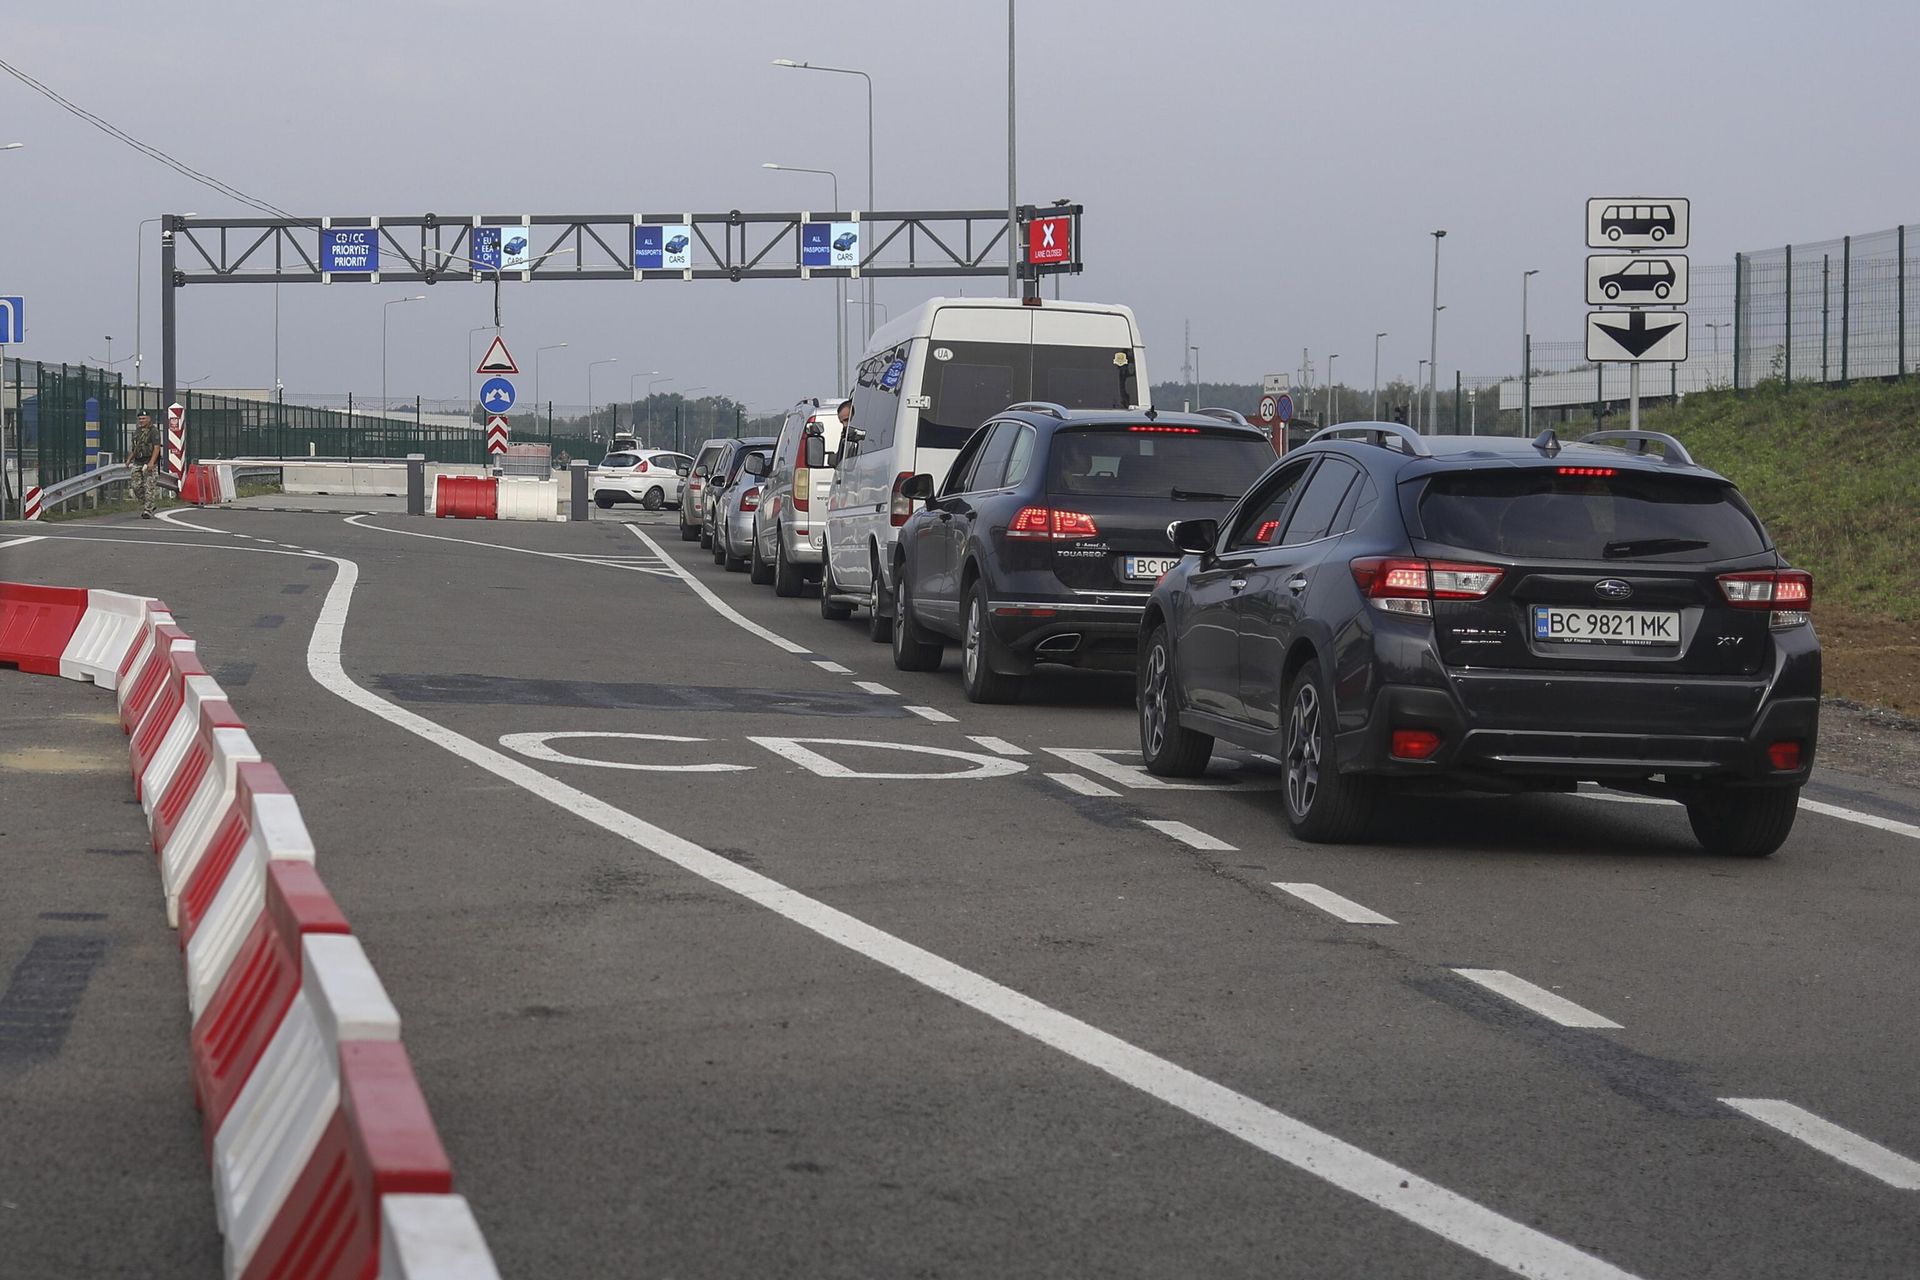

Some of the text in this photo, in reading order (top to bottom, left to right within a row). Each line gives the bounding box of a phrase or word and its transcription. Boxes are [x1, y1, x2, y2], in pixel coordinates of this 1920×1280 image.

[336, 233, 347, 243] CD
[353, 233, 364, 243] CC
[483, 253, 491, 261] CH
[837, 253, 853, 261] CARS
[1046, 248, 1062, 258] CLOSED
[334, 257, 367, 267] PRIORITY
[938, 349, 949, 359] UA
[1262, 403, 1274, 417] 20
[1137, 560, 1157, 573] BC
[1537, 625, 1547, 633] UA
[1551, 613, 1672, 637] BC 9821 MK
